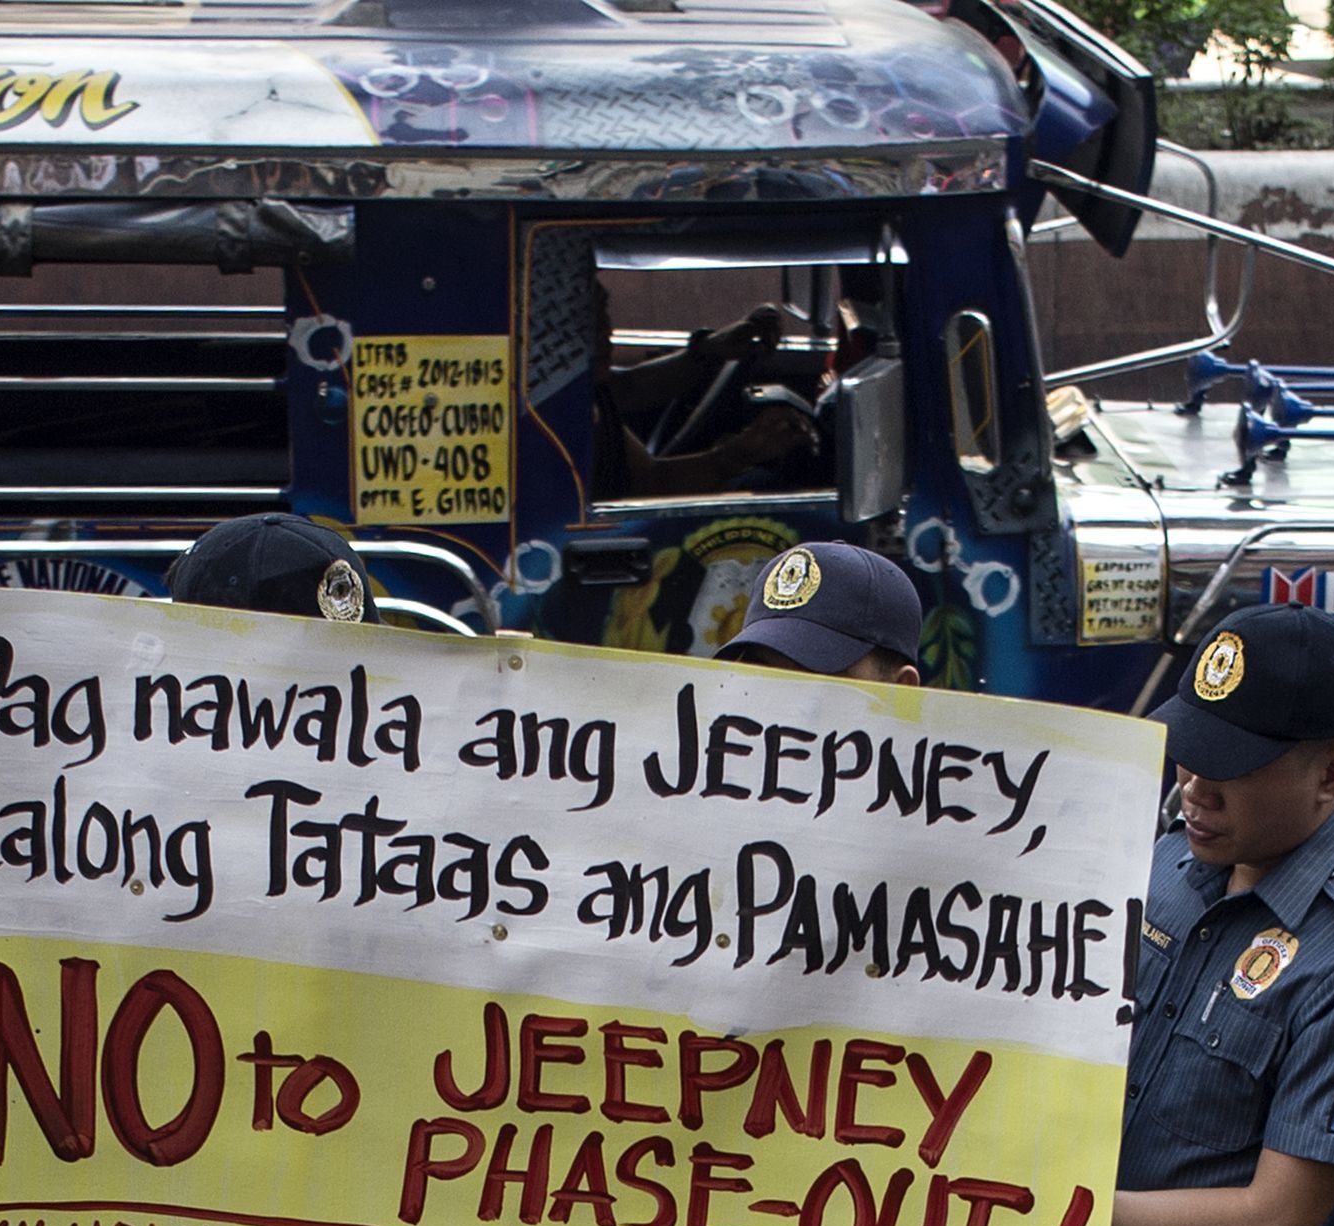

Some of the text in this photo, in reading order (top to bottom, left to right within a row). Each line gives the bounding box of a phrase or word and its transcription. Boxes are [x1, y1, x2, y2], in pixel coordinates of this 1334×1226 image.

[134, 664, 421, 772] nawala
[458, 708, 616, 812] ang
[643, 683, 1051, 857] JEEPNEY,
[245, 780, 549, 922] Tataas
[577, 860, 713, 967] ang
[733, 841, 1143, 1026] PAMASAHE!
[236, 1031, 360, 1136] to
[433, 1002, 992, 1168] JEEPNEY
